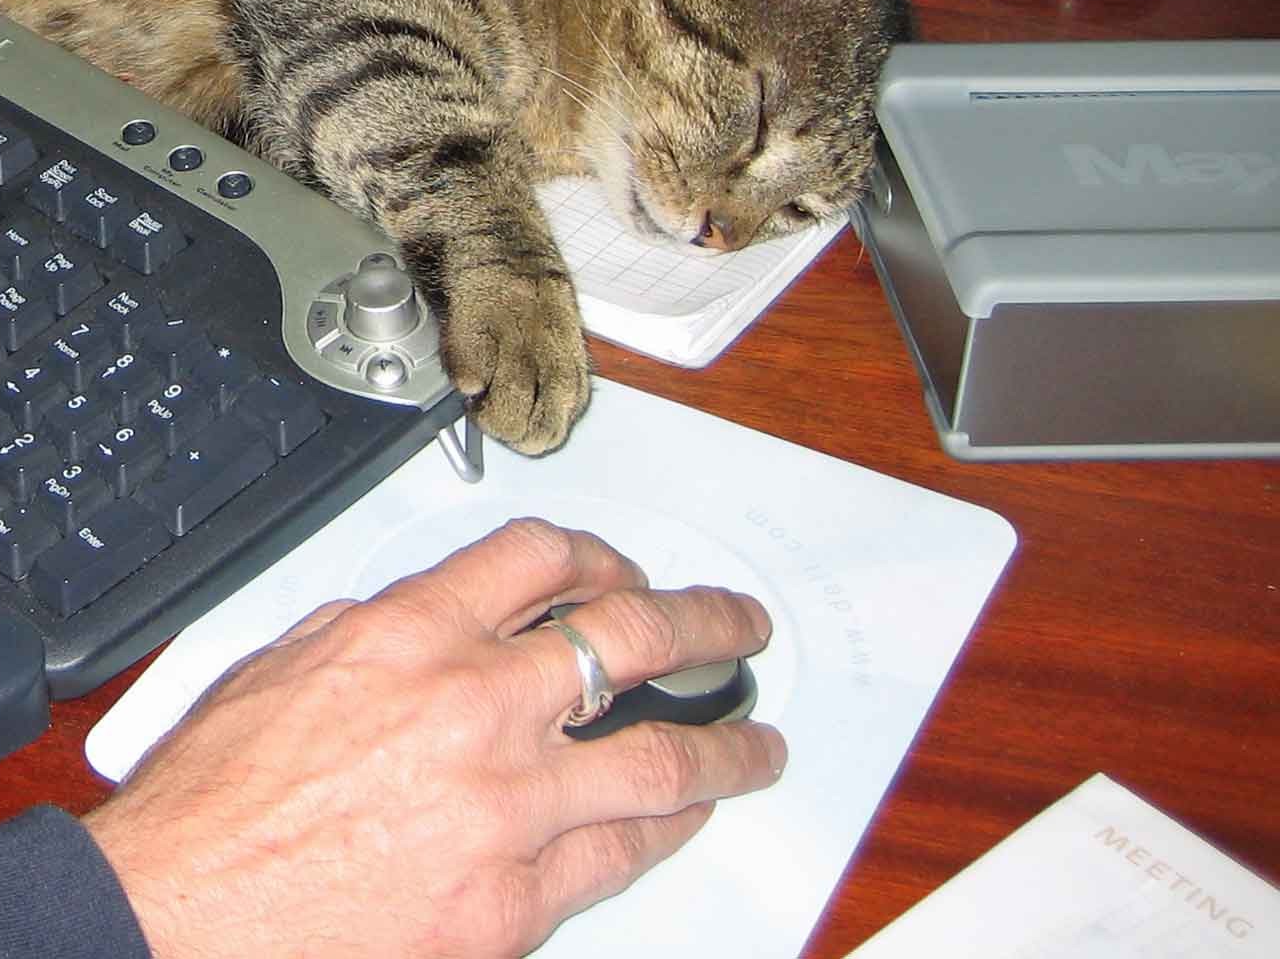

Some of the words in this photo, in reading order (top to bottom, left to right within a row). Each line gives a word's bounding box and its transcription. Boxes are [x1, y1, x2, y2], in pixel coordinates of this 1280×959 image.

[5, 228, 29, 246] Home
[43, 259, 58, 272] Up
[108, 298, 130, 315] Lock
[118, 292, 139, 308] Num
[72, 324, 90, 336] 7
[54, 338, 80, 359] Home
[117, 355, 134, 368] 8
[25, 367, 41, 380] 4
[164, 385, 182, 398] 9
[68, 396, 87, 409] 5
[148, 399, 173, 419] PgUp
[15, 434, 35, 447] 2
[116, 427, 134, 441] 6
[63, 465, 82, 479] 3
[46, 478, 71, 498] PgDn
[78, 527, 105, 549] Enter
[1094, 825, 1256, 940] MEETING
